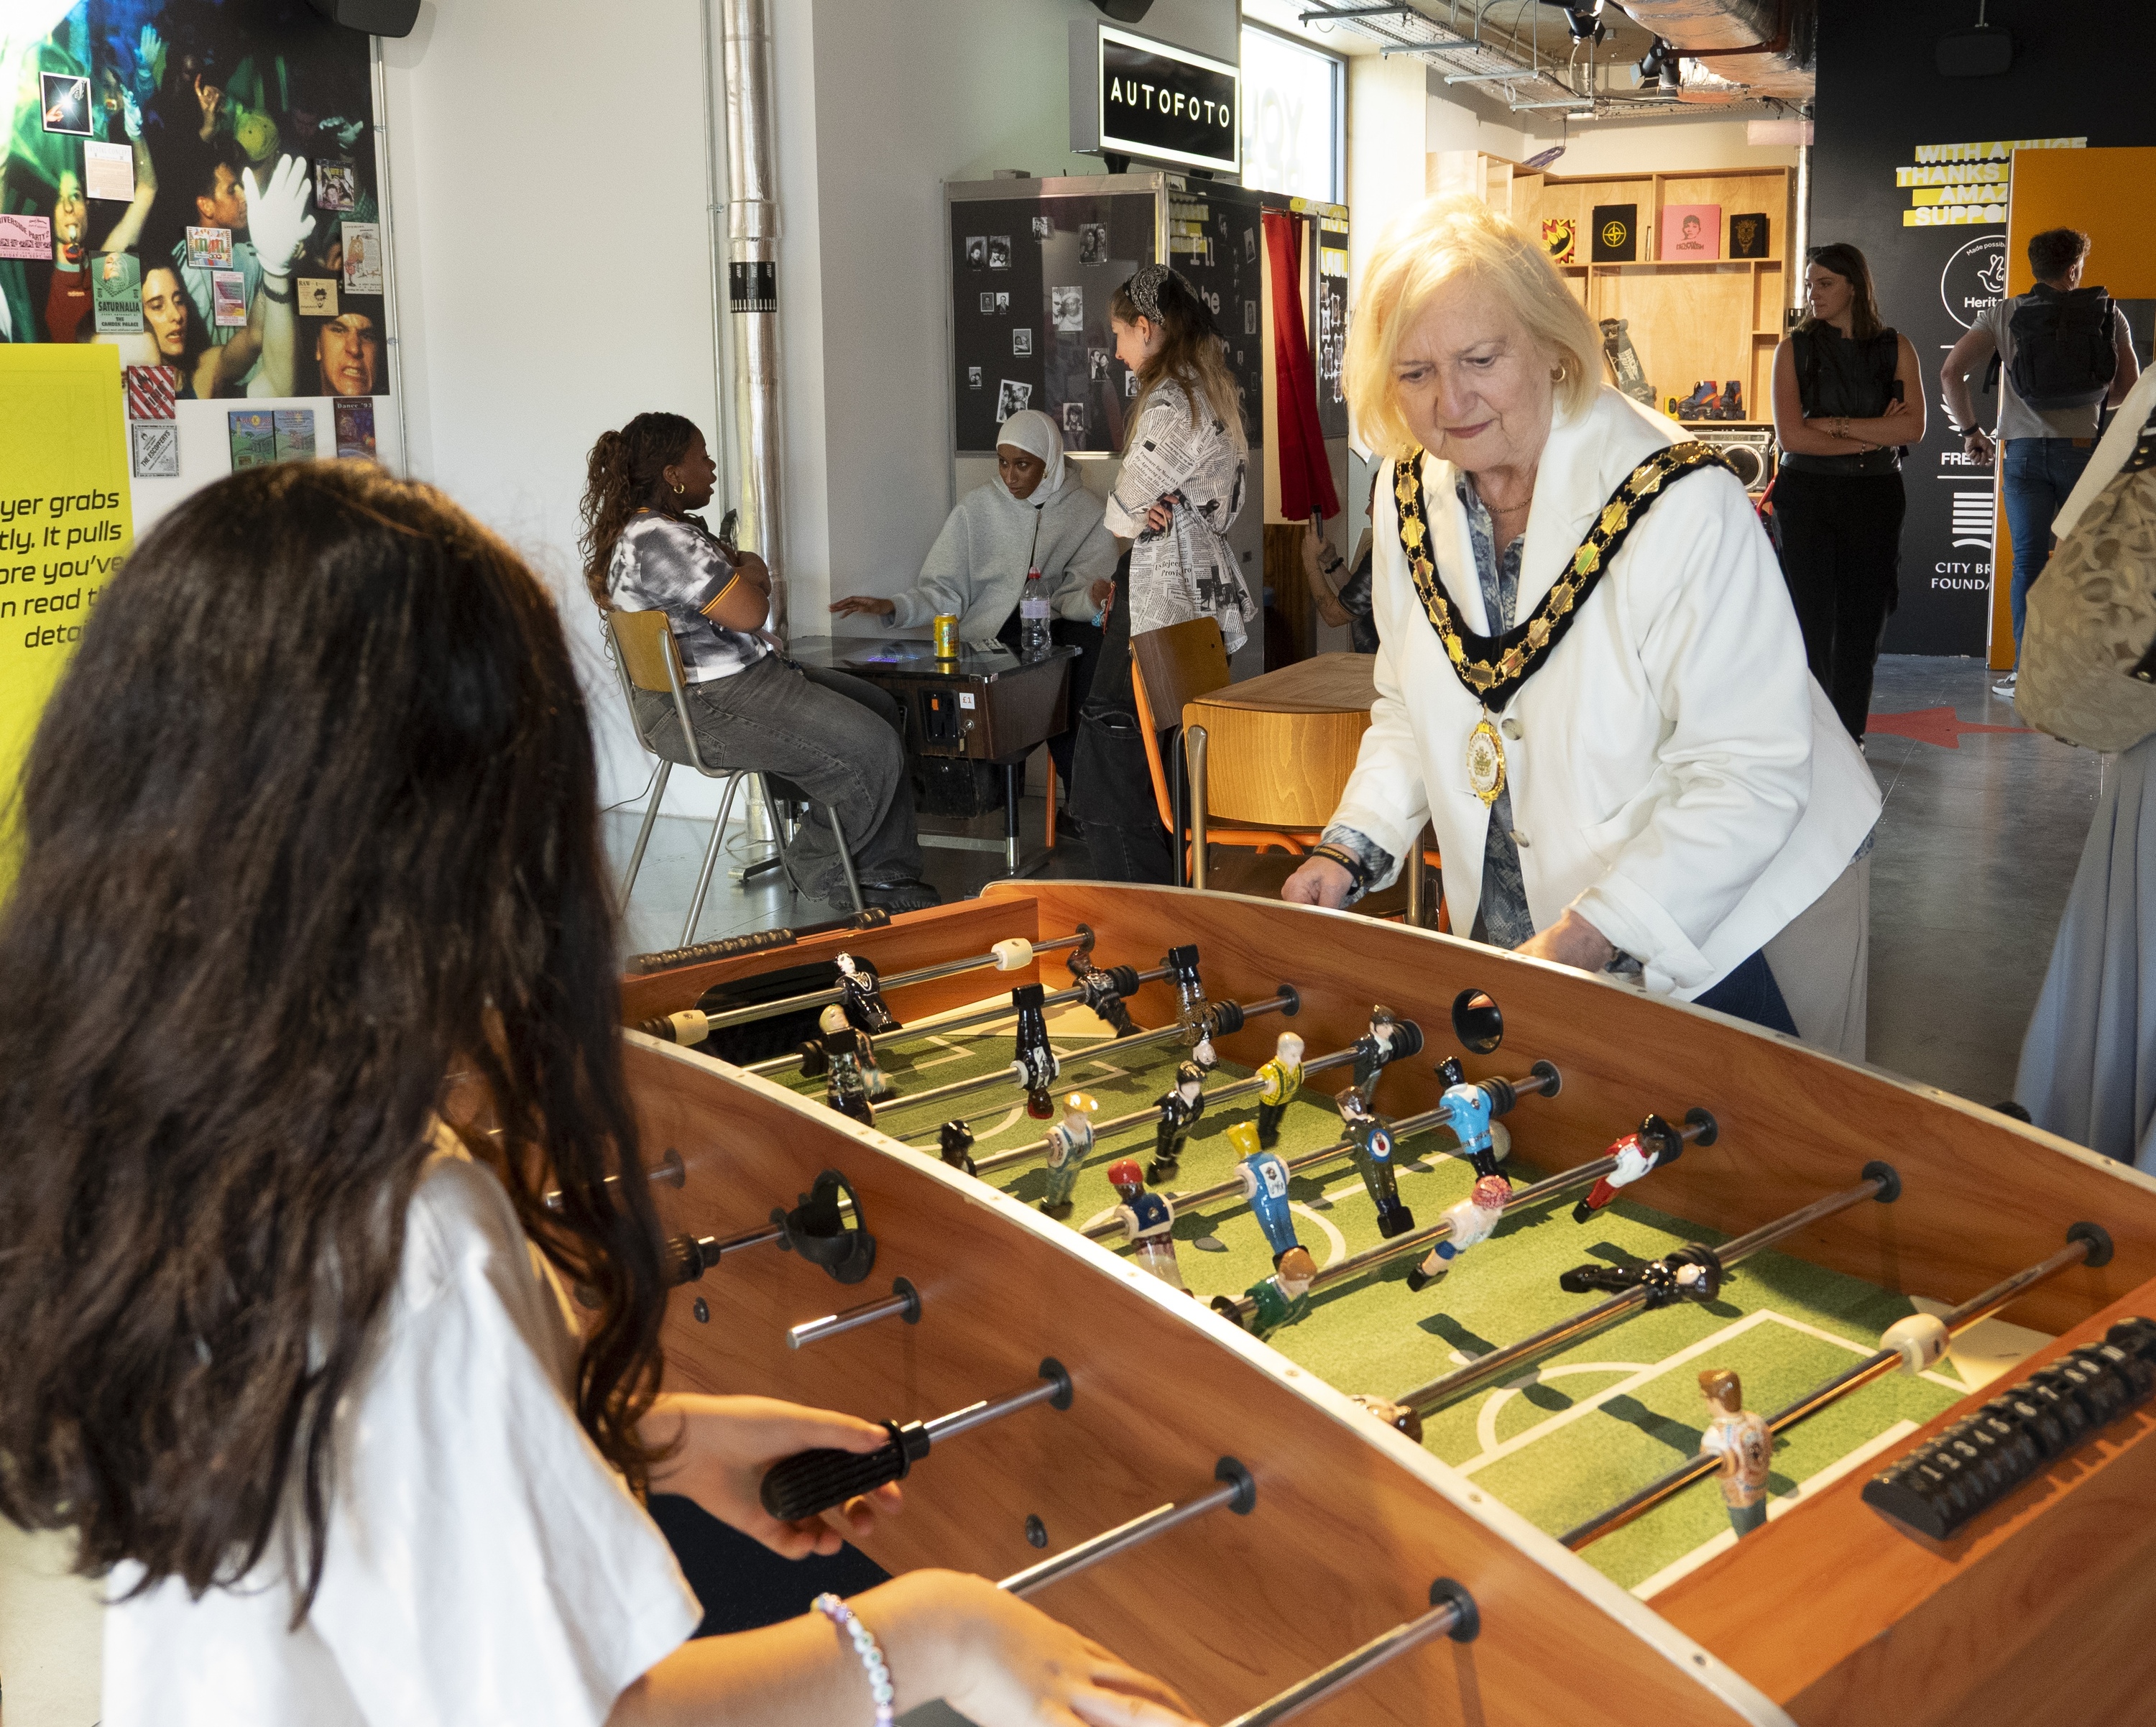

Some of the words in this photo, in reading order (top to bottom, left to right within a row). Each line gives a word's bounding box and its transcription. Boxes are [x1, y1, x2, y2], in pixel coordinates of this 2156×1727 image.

[1111, 77, 1230, 128] AUTOFOTO
[1917, 143, 1981, 164] WITH
[1988, 142, 2007, 160] A
[1896, 162, 1999, 186] THANKS
[1915, 204, 2007, 226] SUPPO
[1966, 244, 1984, 257] Made
[98, 301, 140, 312] SATURNALIA
[141, 456, 151, 467] THE
[1941, 452, 1976, 466] FRE
[1, 497, 43, 522] yer
[50, 489, 119, 519] grabs
[43, 525, 60, 547] It
[67, 520, 122, 551] pulls
[43, 555, 124, 586] you've
[1935, 562, 1971, 574] CITY
[24, 588, 80, 616] read
